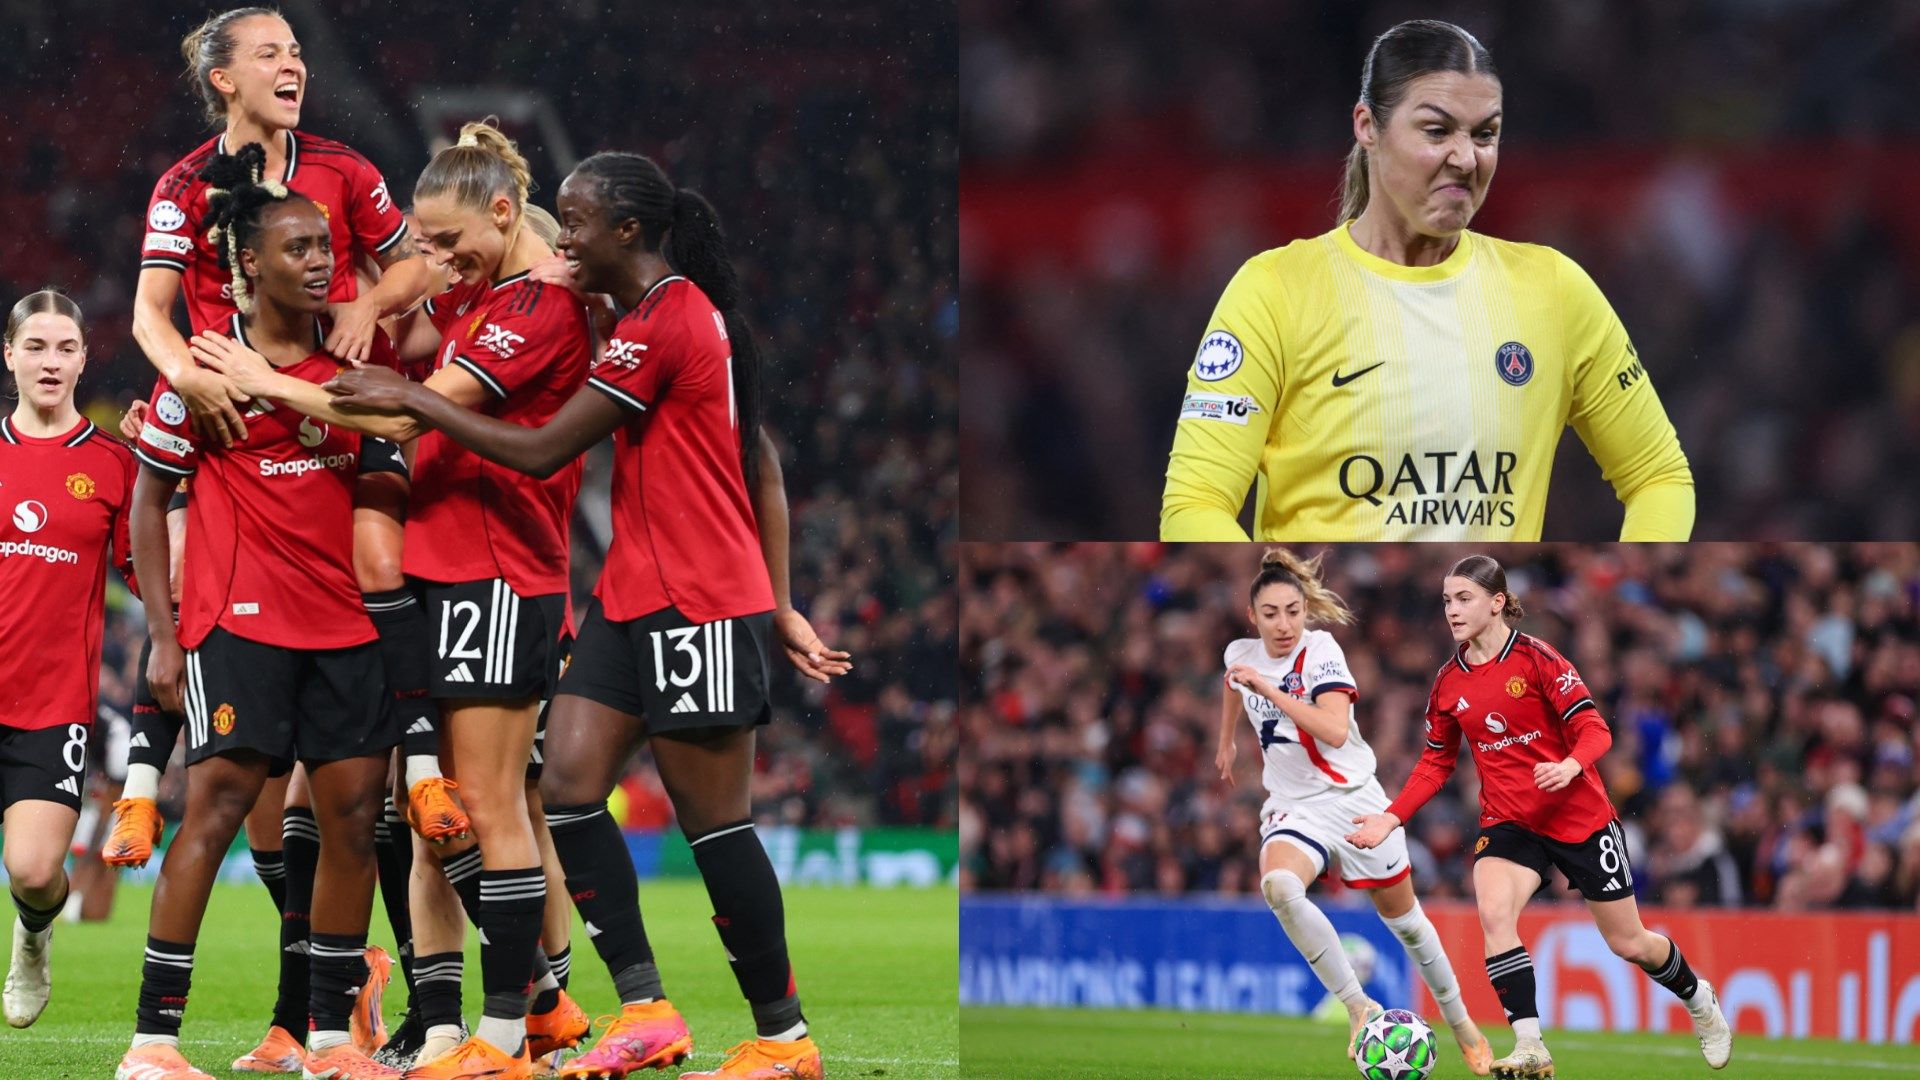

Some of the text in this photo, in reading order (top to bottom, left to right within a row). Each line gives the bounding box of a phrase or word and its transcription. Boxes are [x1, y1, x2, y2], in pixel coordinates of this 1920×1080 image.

[1501, 344, 1526, 356] PARIS
[1617, 359, 1643, 391] RW
[1226, 400, 1247, 417] 10
[1339, 450, 1517, 506] QATAR
[1385, 500, 1516, 527] AIRWAYS
[437, 600, 483, 660] 12
[649, 625, 703, 693] 13
[1261, 710, 1286, 719] AIRW
[62, 723, 88, 773] 8
[1477, 730, 1542, 753] Snapdragon
[1599, 834, 1620, 874] 8
